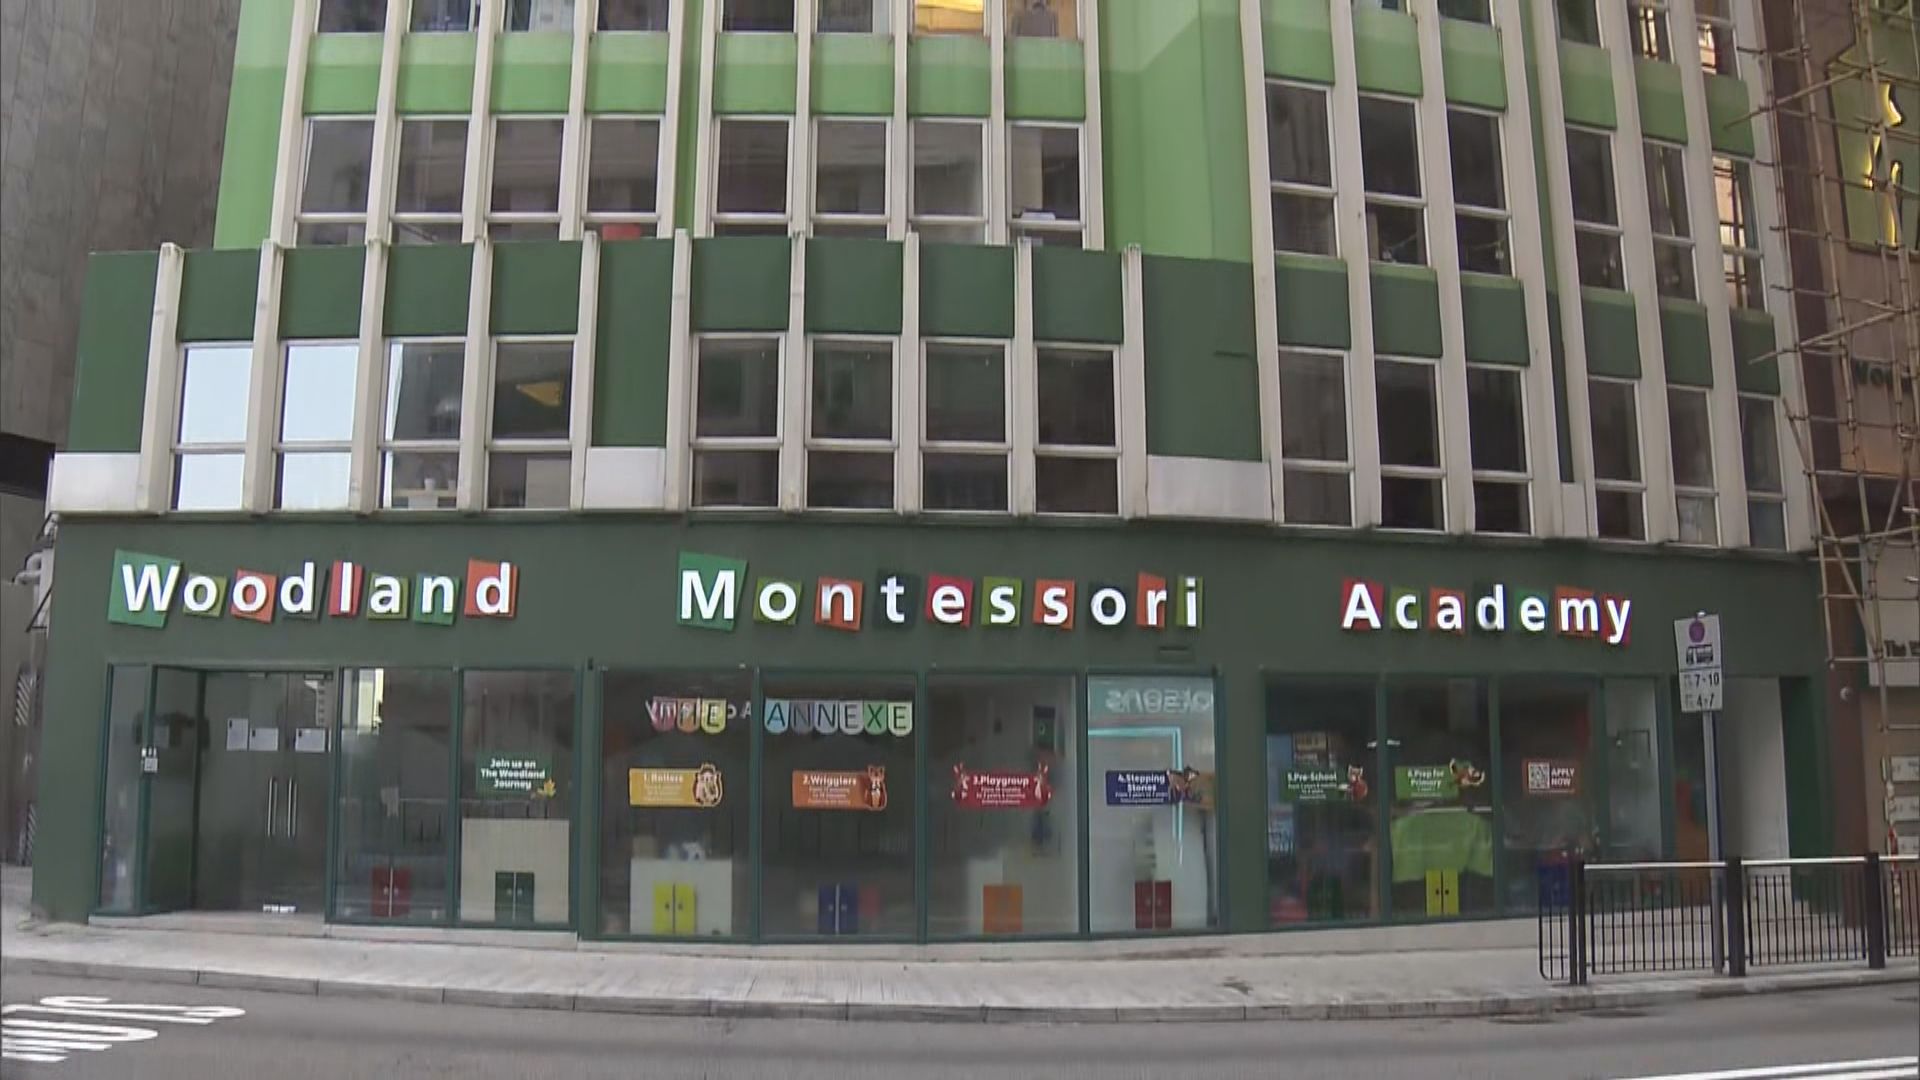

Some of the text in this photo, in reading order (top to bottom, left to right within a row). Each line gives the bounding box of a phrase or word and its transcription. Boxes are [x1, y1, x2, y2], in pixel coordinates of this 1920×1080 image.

[122, 562, 1631, 644] Woodland Montessori Academy
[766, 702, 907, 730] ANNEXE
[490, 758, 536, 768] Join us on
[481, 768, 545, 779] The Woodland
[1551, 768, 1575, 777] APPLY
[494, 778, 532, 791] Journey
[1551, 778, 1571, 786] NOW
